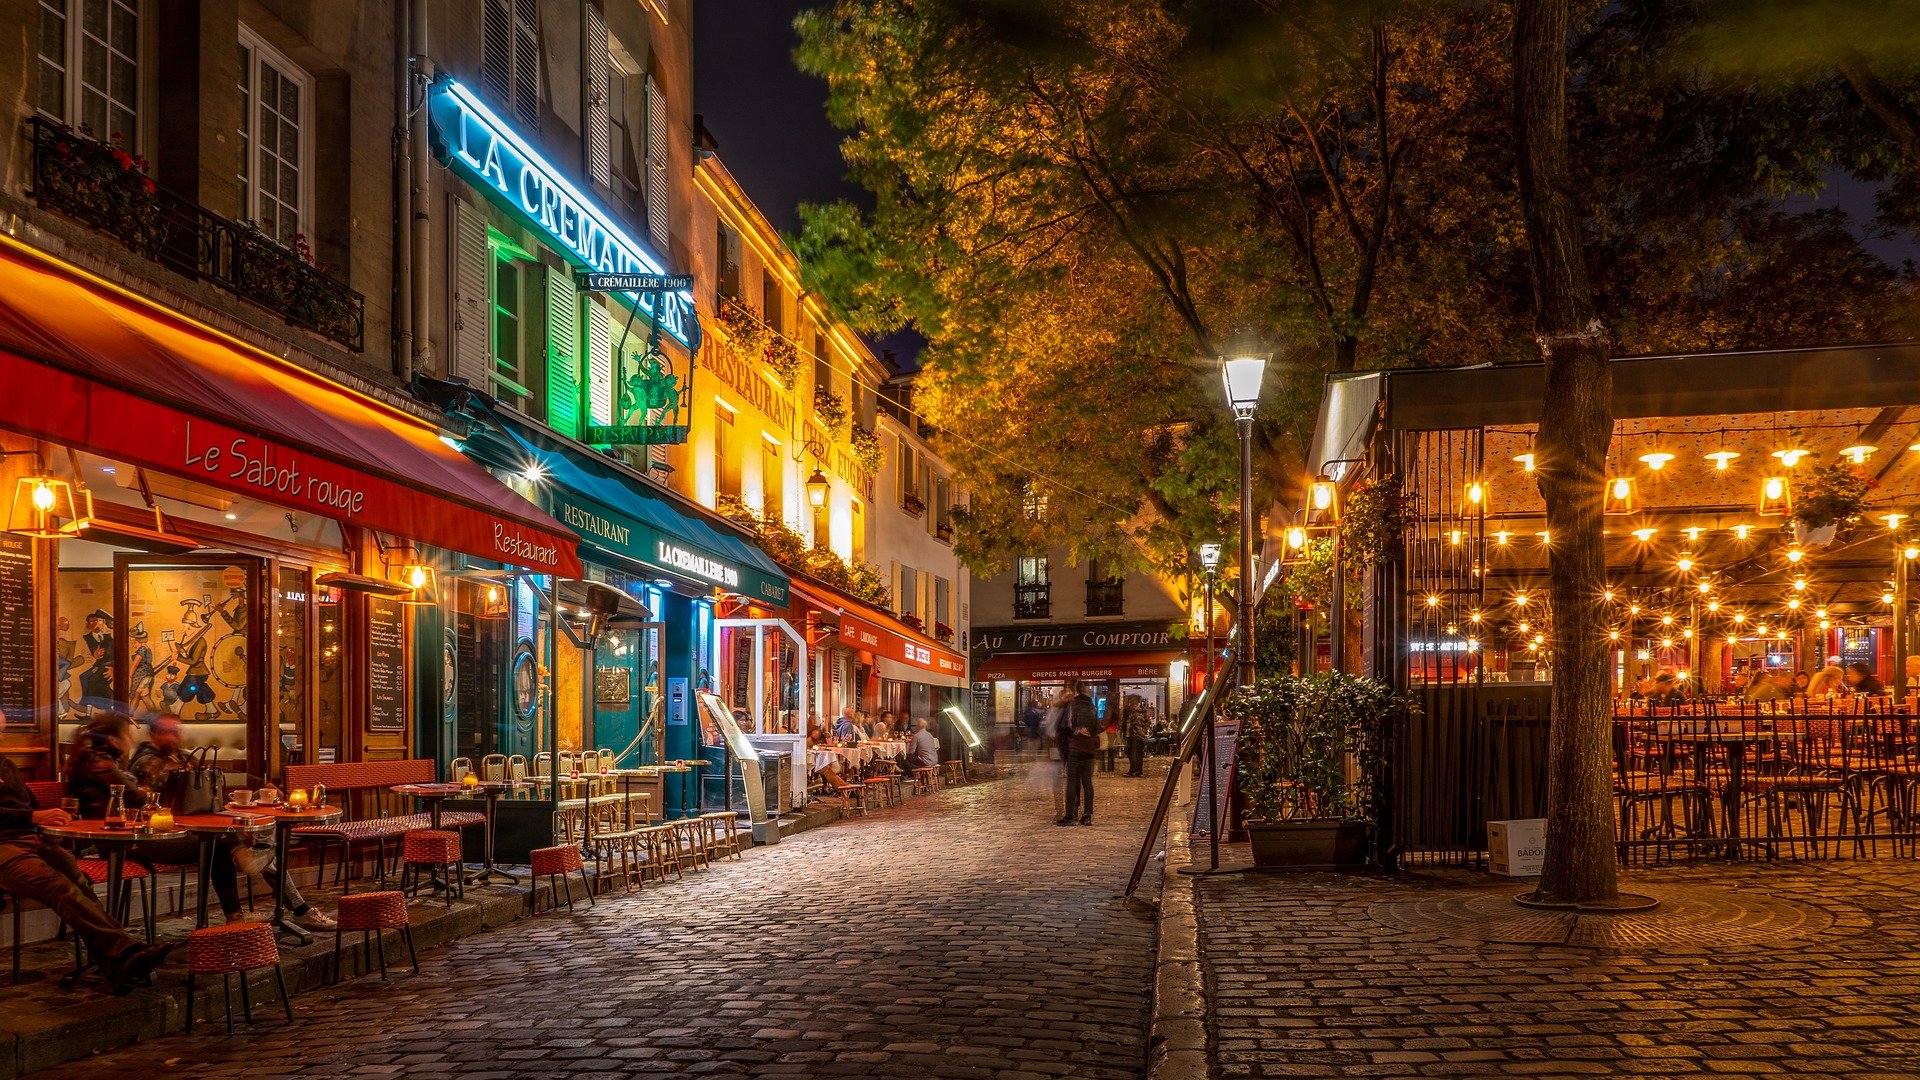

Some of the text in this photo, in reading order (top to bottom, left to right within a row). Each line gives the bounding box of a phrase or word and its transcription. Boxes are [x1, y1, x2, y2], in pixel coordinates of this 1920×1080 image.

[458, 104, 509, 192] LA
[183, 420, 364, 518] Le Sabot rouge
[494, 521, 559, 566] Restaurant
[564, 502, 630, 546] RESTAURANT
[760, 581, 785, 601] CABARET
[1081, 669, 1113, 677] BURGERS
